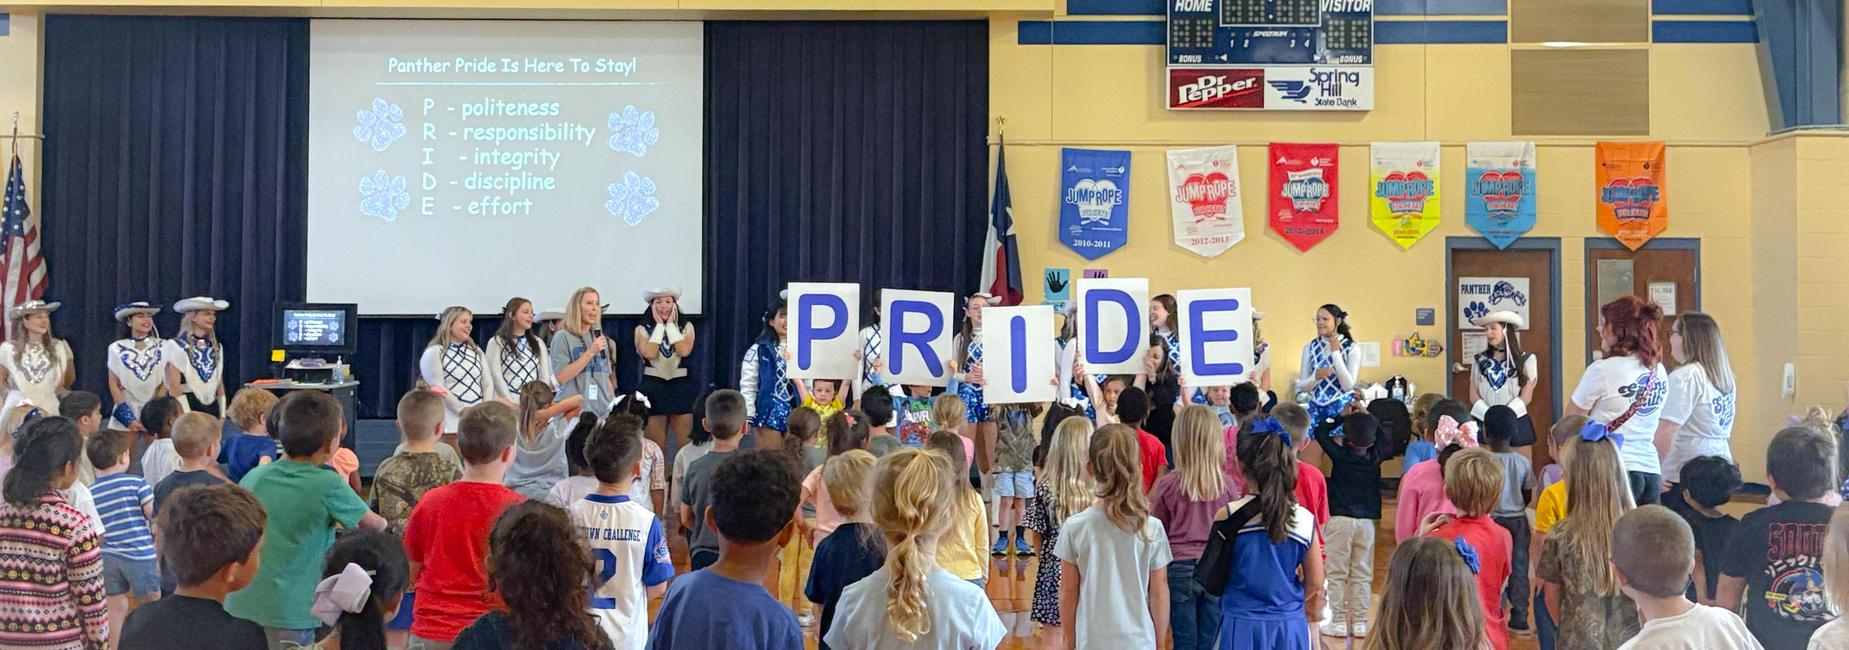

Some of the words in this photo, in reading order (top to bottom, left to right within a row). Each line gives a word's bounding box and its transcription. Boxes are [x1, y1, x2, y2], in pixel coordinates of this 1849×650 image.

[1175, 0, 1213, 12] HOME
[1321, 0, 1371, 12] VISITOR
[1243, 39, 1249, 48] 2
[1290, 39, 1296, 48] 3
[1304, 39, 1310, 48] 4
[1178, 55, 1202, 63] BONUS
[1339, 55, 1363, 63] BONUS
[388, 57, 450, 74] Panther
[455, 57, 496, 73] Pride
[501, 58, 519, 73] Is
[525, 58, 564, 73] Here
[569, 58, 590, 73] To
[595, 57, 637, 77] Stay!
[1198, 74, 1227, 88] Dr
[1308, 68, 1360, 87] Spring
[1178, 77, 1256, 105] Pepper
[1320, 82, 1342, 97] Hill
[423, 98, 435, 116] P
[462, 98, 560, 120] politeness
[1315, 98, 1335, 106] State
[1337, 98, 1357, 106] Bank
[423, 123, 436, 140] R
[463, 123, 596, 146] responsibility
[421, 148, 434, 165] I
[474, 148, 560, 170] integrity
[422, 172, 437, 190] D
[464, 172, 555, 195] discipline
[1375, 181, 1406, 198] JUMP
[1406, 180, 1434, 197] ROPE
[1066, 187, 1095, 205] JUMP
[1095, 188, 1122, 206] ROPE
[1176, 184, 1206, 203] JUMP
[1207, 180, 1236, 202] ROPE
[421, 197, 434, 215] E
[467, 197, 533, 216] effort
[1073, 238, 1111, 248] 2010-2011
[1461, 284, 1491, 295] PANTHER
[603, 528, 641, 542] CHALLENGE
